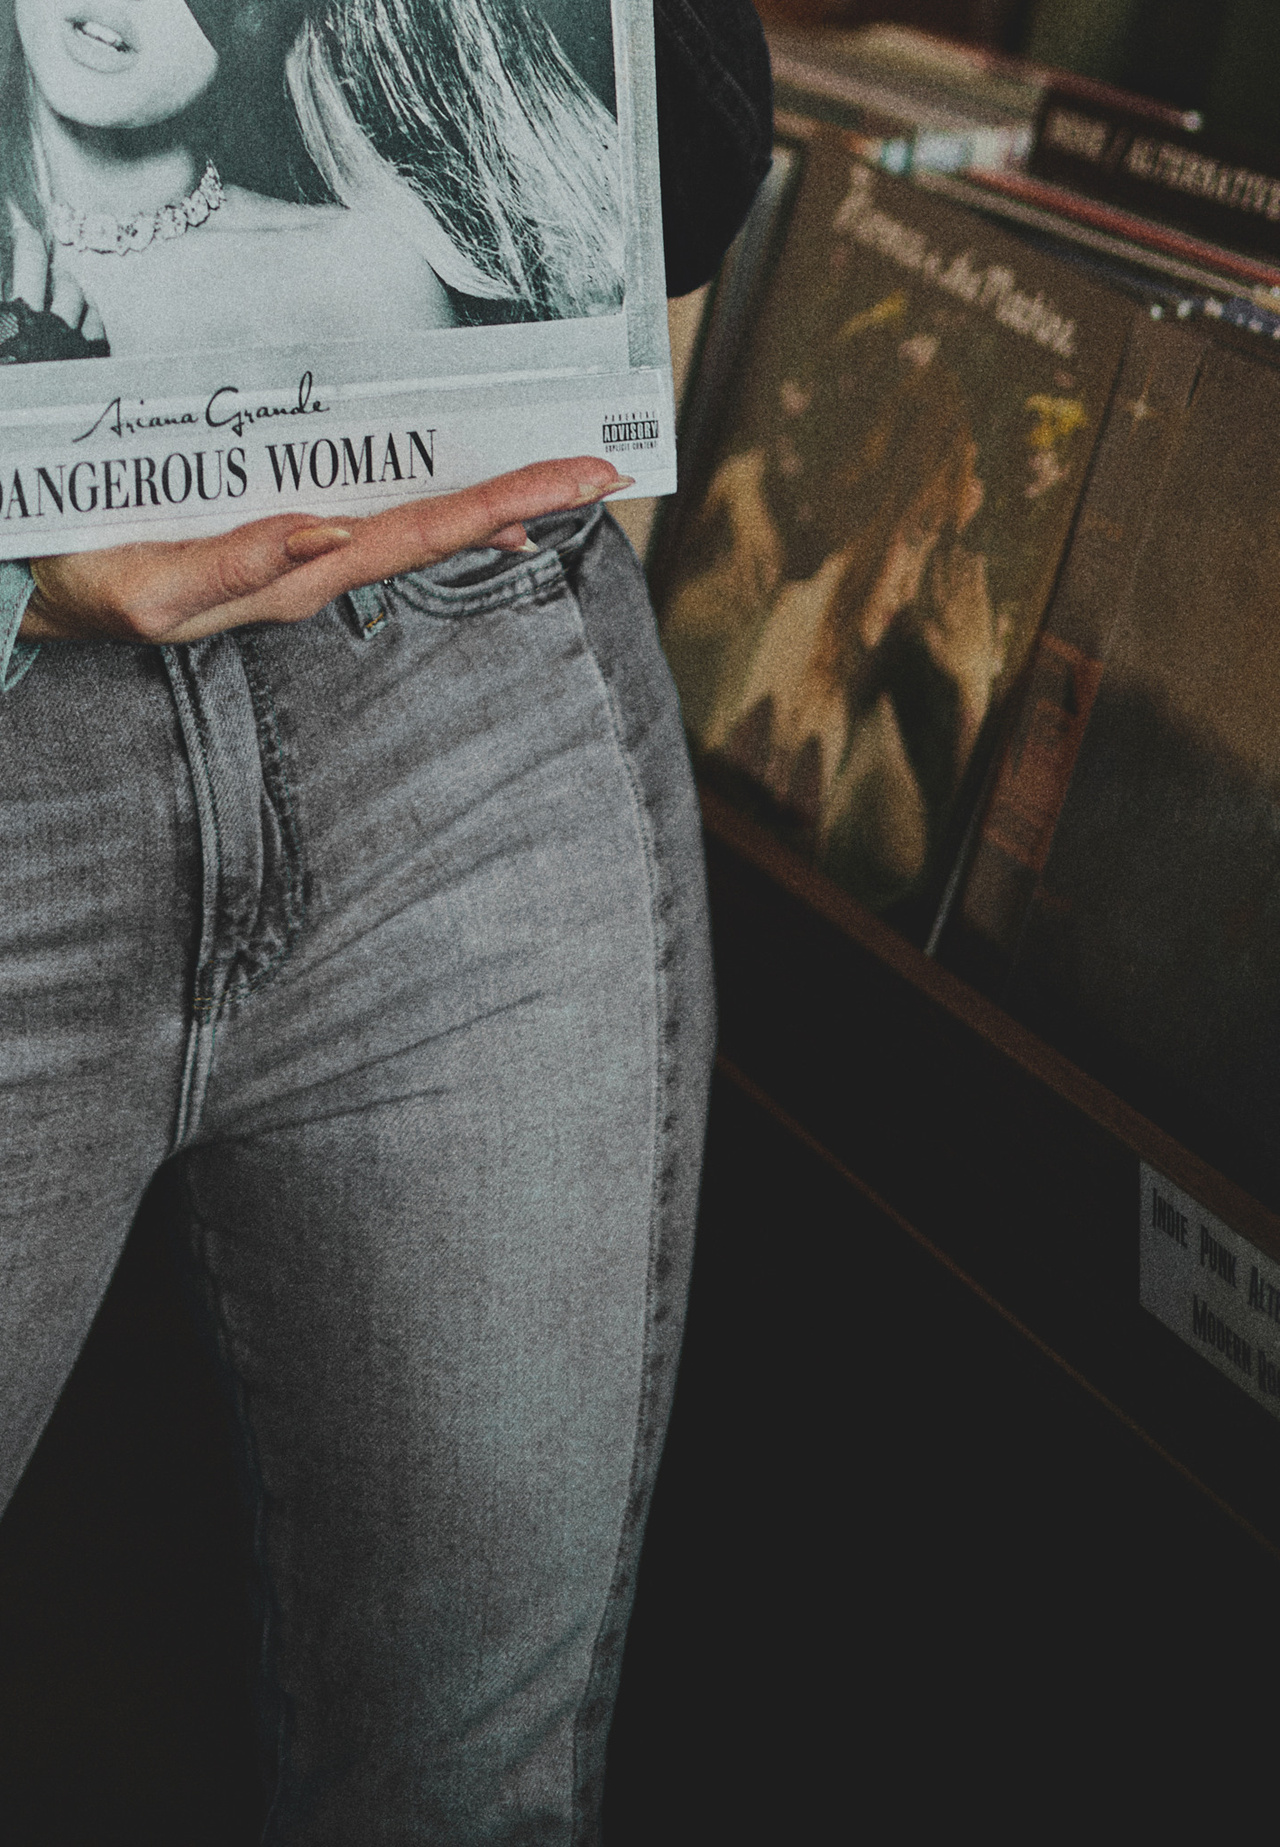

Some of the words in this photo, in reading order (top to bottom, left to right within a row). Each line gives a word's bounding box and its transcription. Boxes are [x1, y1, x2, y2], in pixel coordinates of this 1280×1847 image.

[71, 396, 200, 444] Ariana
[204, 370, 331, 438] Grande
[603, 420, 658, 443] ADVISORY
[264, 428, 437, 494] WOMAN
